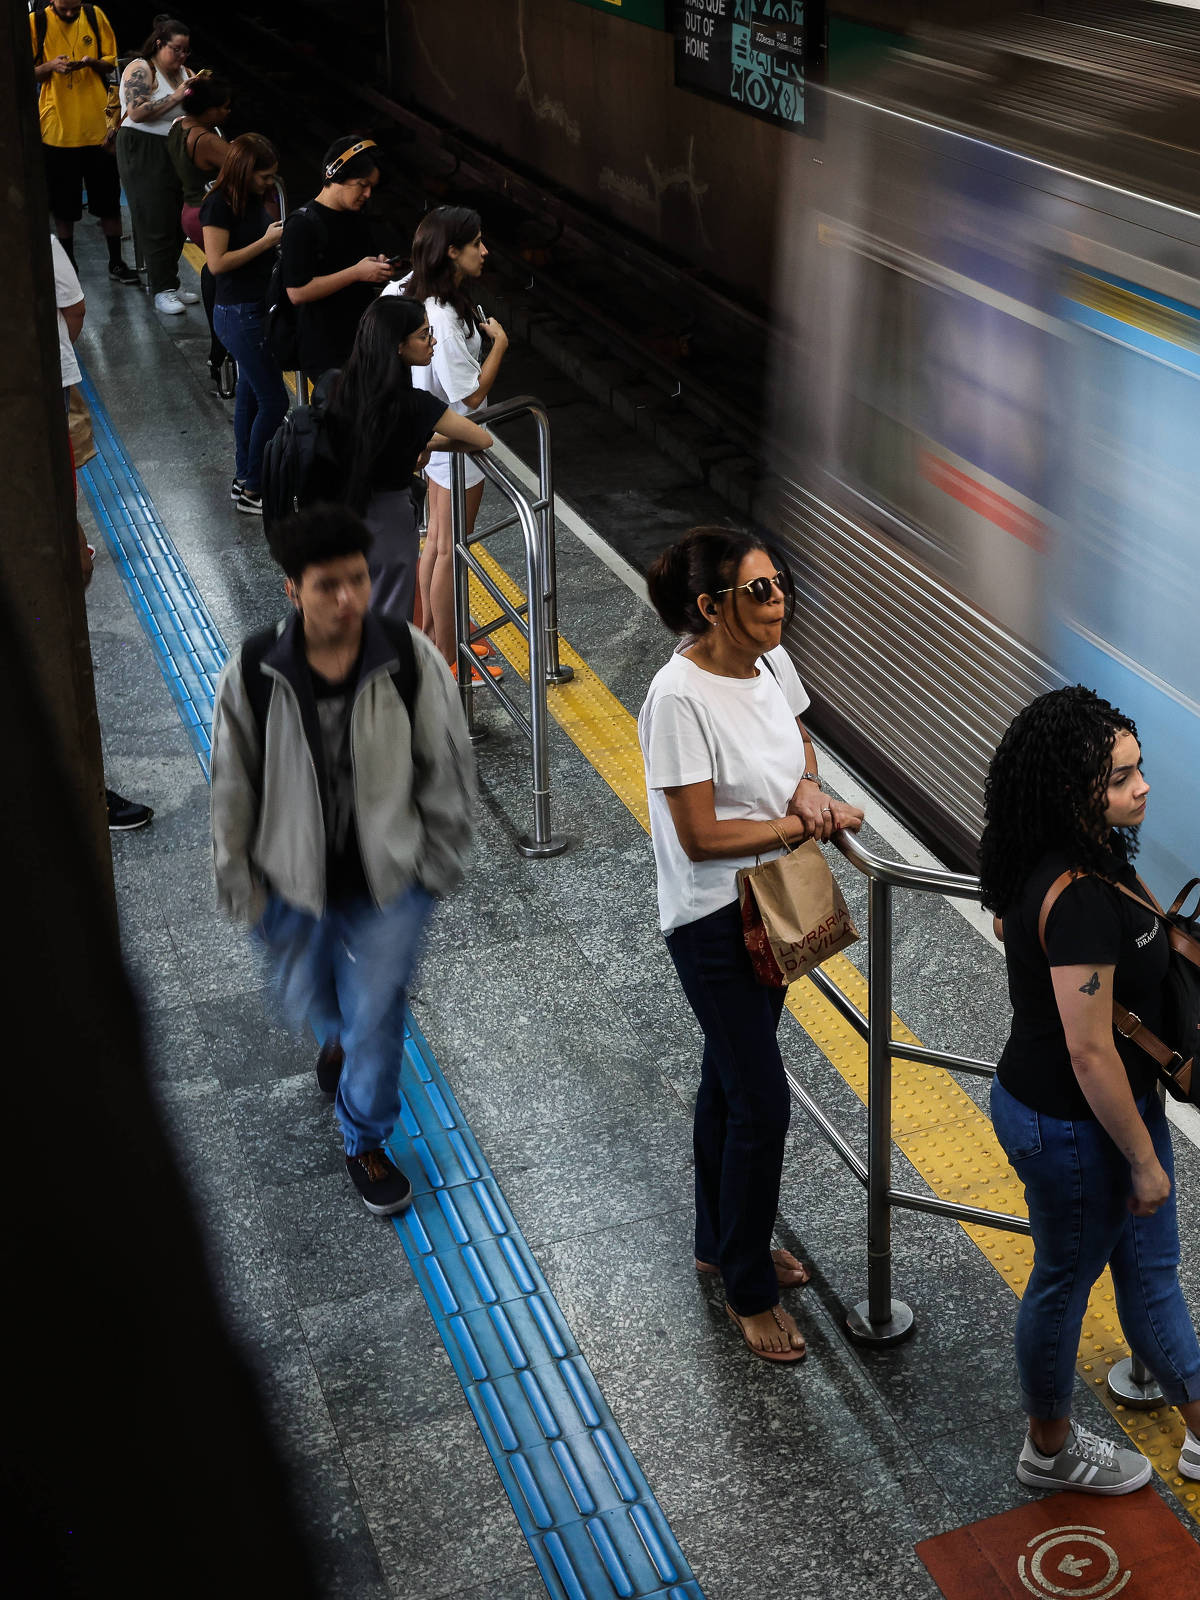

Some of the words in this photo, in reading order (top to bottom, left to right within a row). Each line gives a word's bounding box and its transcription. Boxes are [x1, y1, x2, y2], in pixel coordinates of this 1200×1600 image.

[685, 11, 702, 33] OUT
[703, 17, 715, 37] OF
[685, 36, 709, 61] HOME
[793, 35, 802, 47] DE
[779, 908, 848, 957] LIVRARIA
[784, 955, 808, 971] DA
[809, 922, 853, 954] VILA
